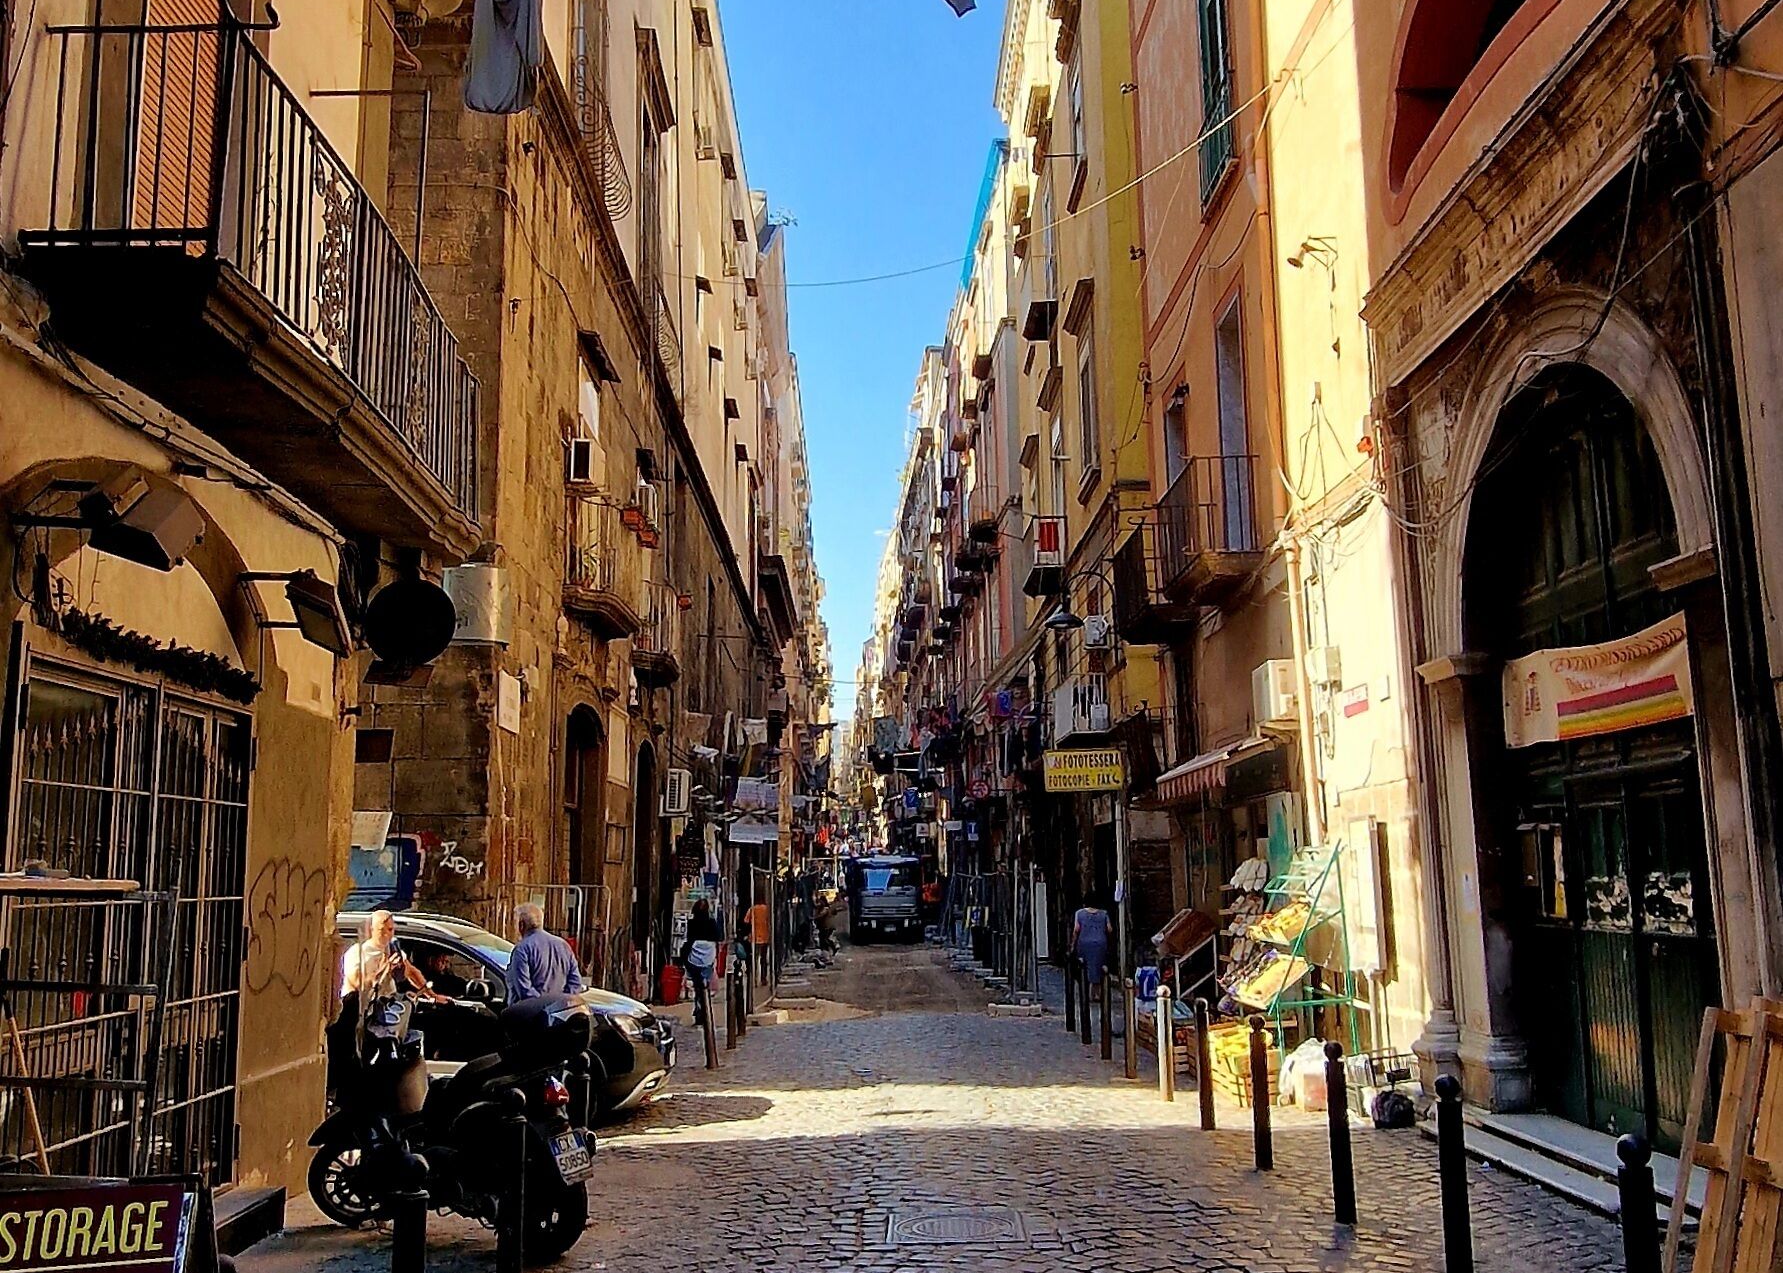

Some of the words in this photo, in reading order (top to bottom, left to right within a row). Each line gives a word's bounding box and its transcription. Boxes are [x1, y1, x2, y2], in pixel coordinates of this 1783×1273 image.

[1063, 753, 1120, 769] FOTOTESSERA
[1049, 774, 1090, 787] FOTOCOPIE
[1097, 773, 1111, 786] FAX
[560, 1151, 589, 1172] 50850
[0, 1201, 169, 1264] STORAGE
